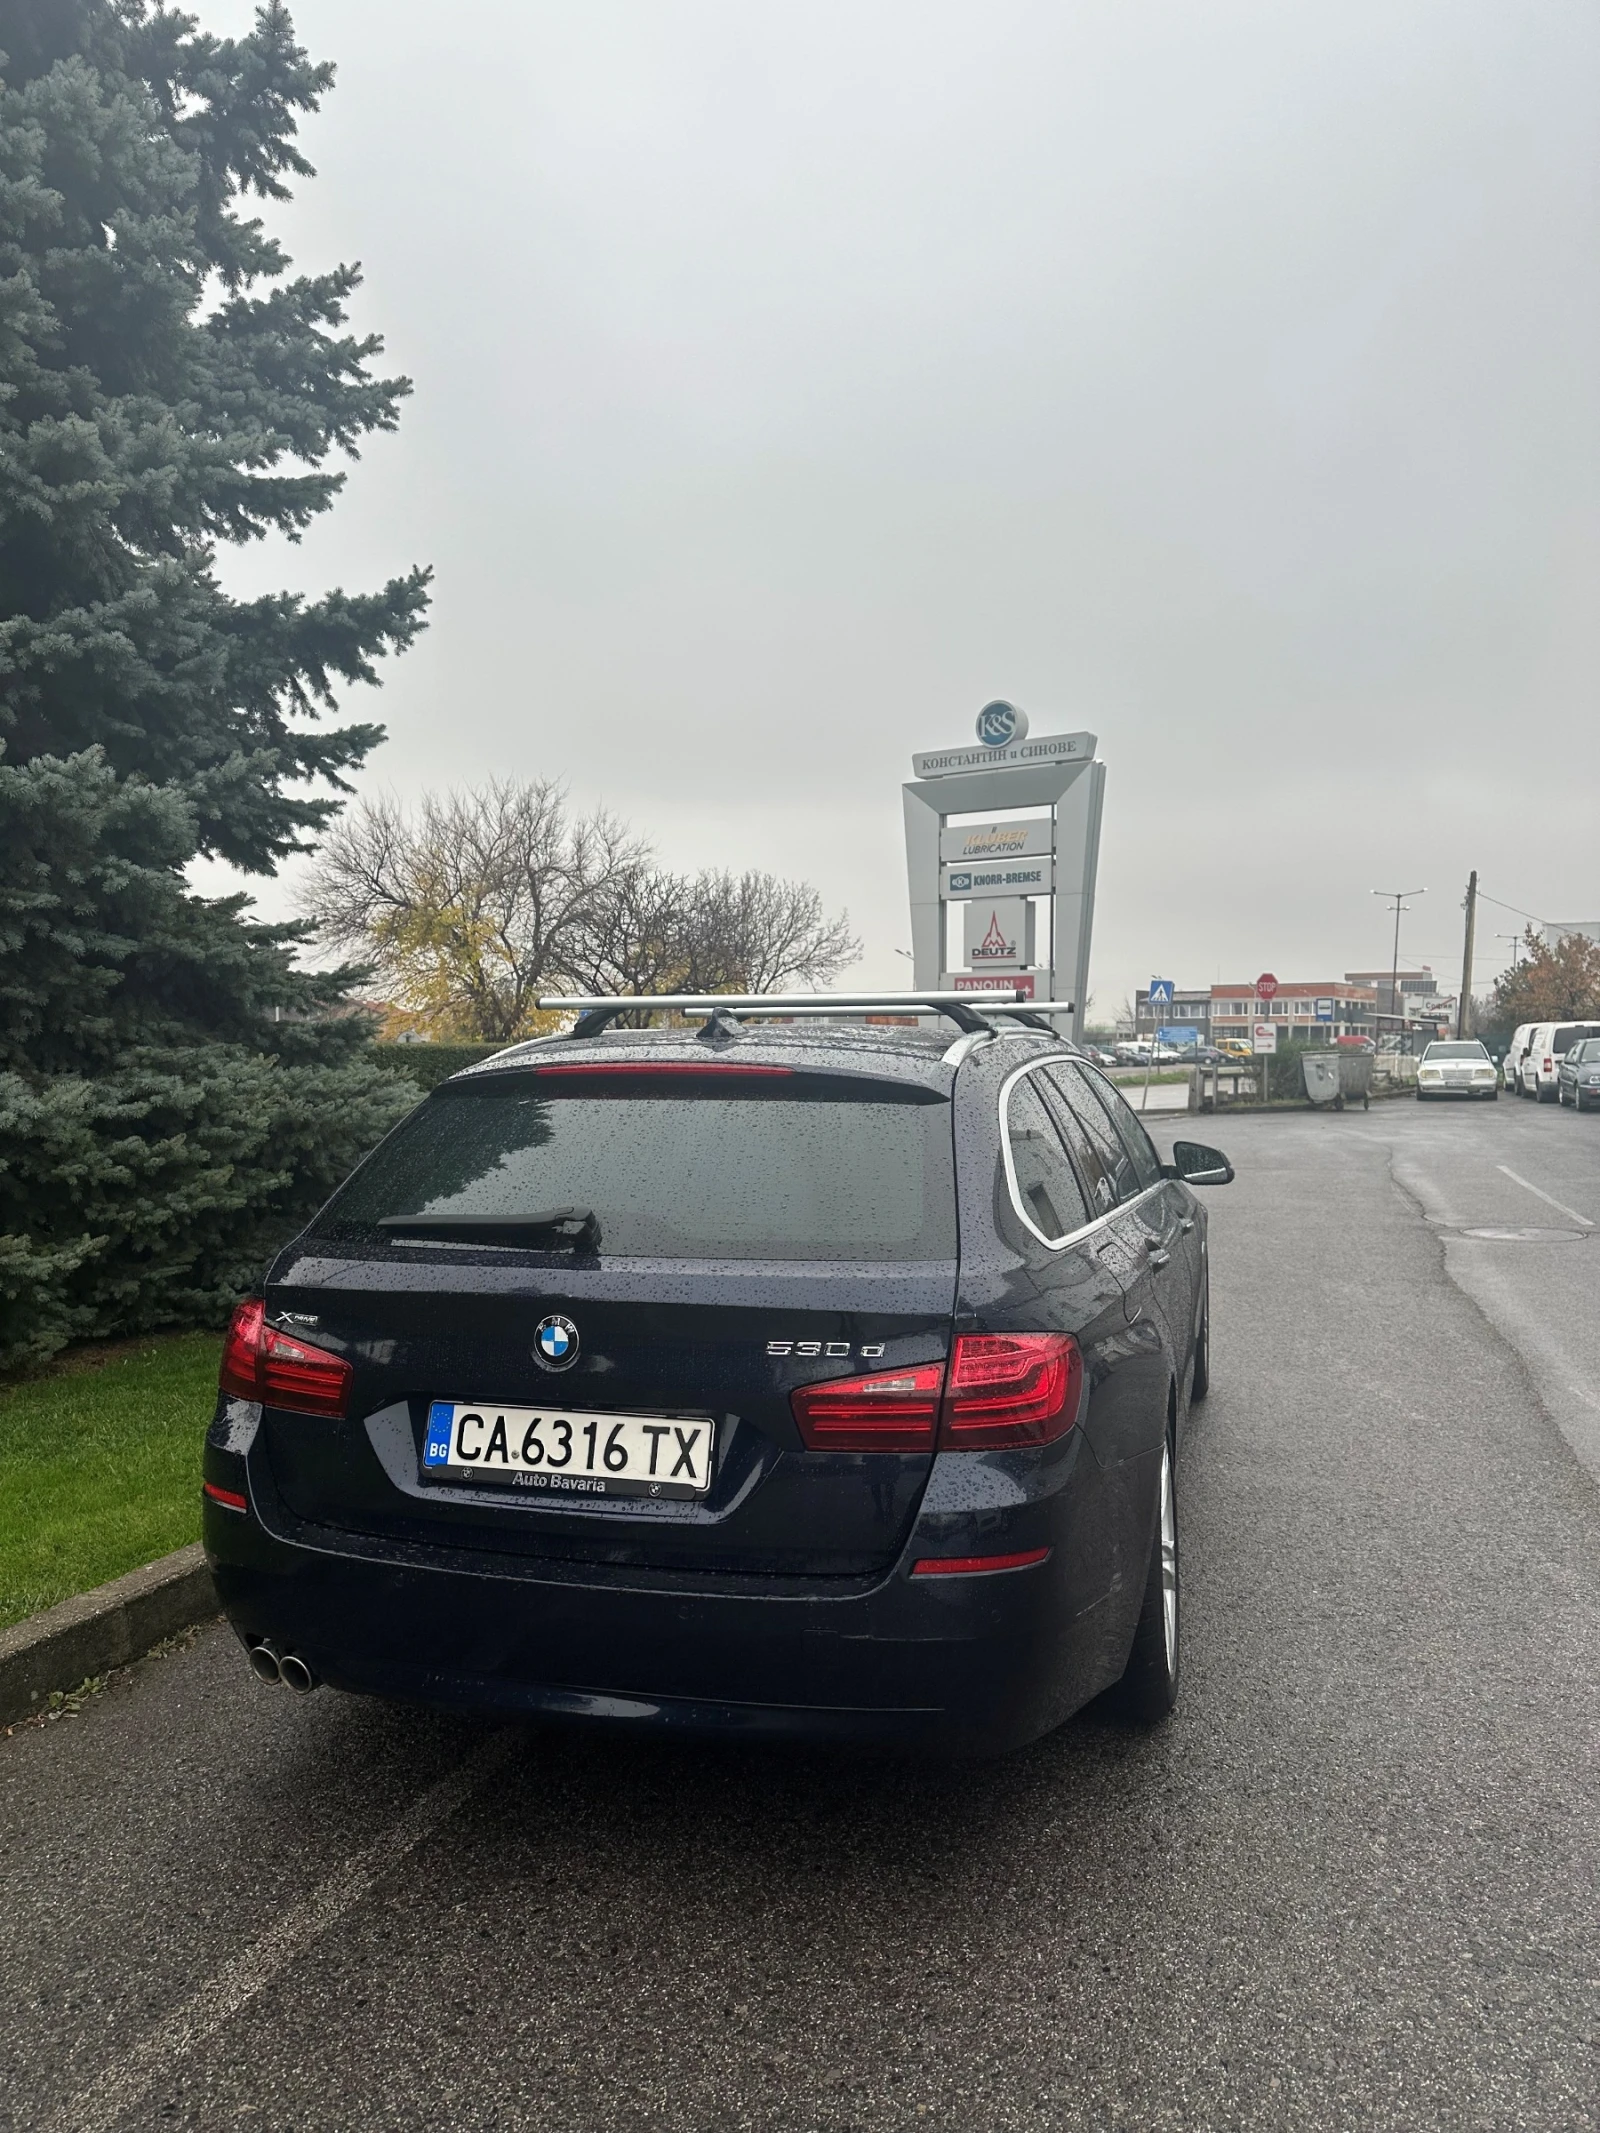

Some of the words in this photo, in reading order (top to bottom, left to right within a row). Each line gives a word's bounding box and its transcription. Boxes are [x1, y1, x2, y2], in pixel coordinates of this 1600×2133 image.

[979, 710, 1015, 737] K&S
[922, 749, 1007, 770] КОНСТАНТИН
[1020, 740, 1077, 759] СИНОВЕ
[962, 841, 1025, 855] LUBRICATION
[973, 870, 1042, 886] KNORR-BREMSE
[971, 946, 1017, 956] DEUTZ
[956, 979, 1014, 991] PANOLIN
[1258, 981, 1276, 992] STOP
[538, 1317, 575, 1334] BMW
[765, 1340, 851, 1357] 530
[429, 1442, 448, 1458] BG
[511, 1470, 548, 1487] Auto
[549, 1474, 607, 1492] Bavaria
